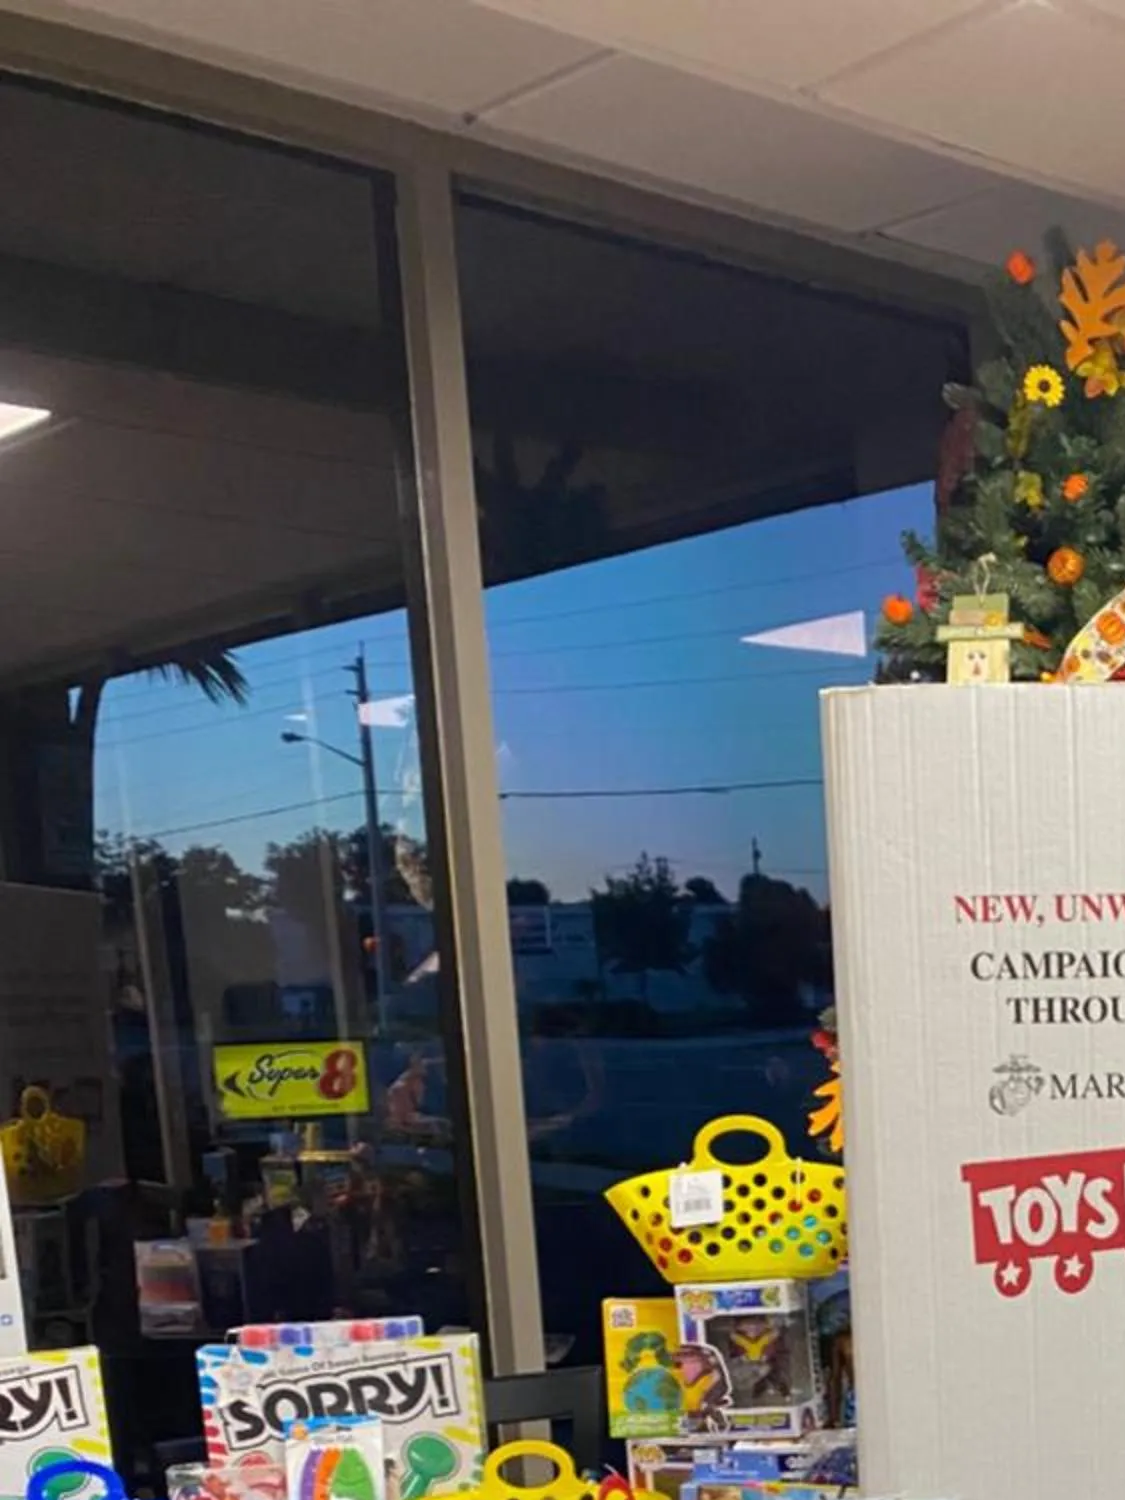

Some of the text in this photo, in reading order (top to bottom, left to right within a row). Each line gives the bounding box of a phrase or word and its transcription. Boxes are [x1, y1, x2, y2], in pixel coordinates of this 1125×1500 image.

[954, 895, 1044, 928] NEW,
[248, 1048, 358, 1100] Super 8
[978, 1171, 1121, 1248] TOYS
[228, 1364, 451, 1443] SORRY!
